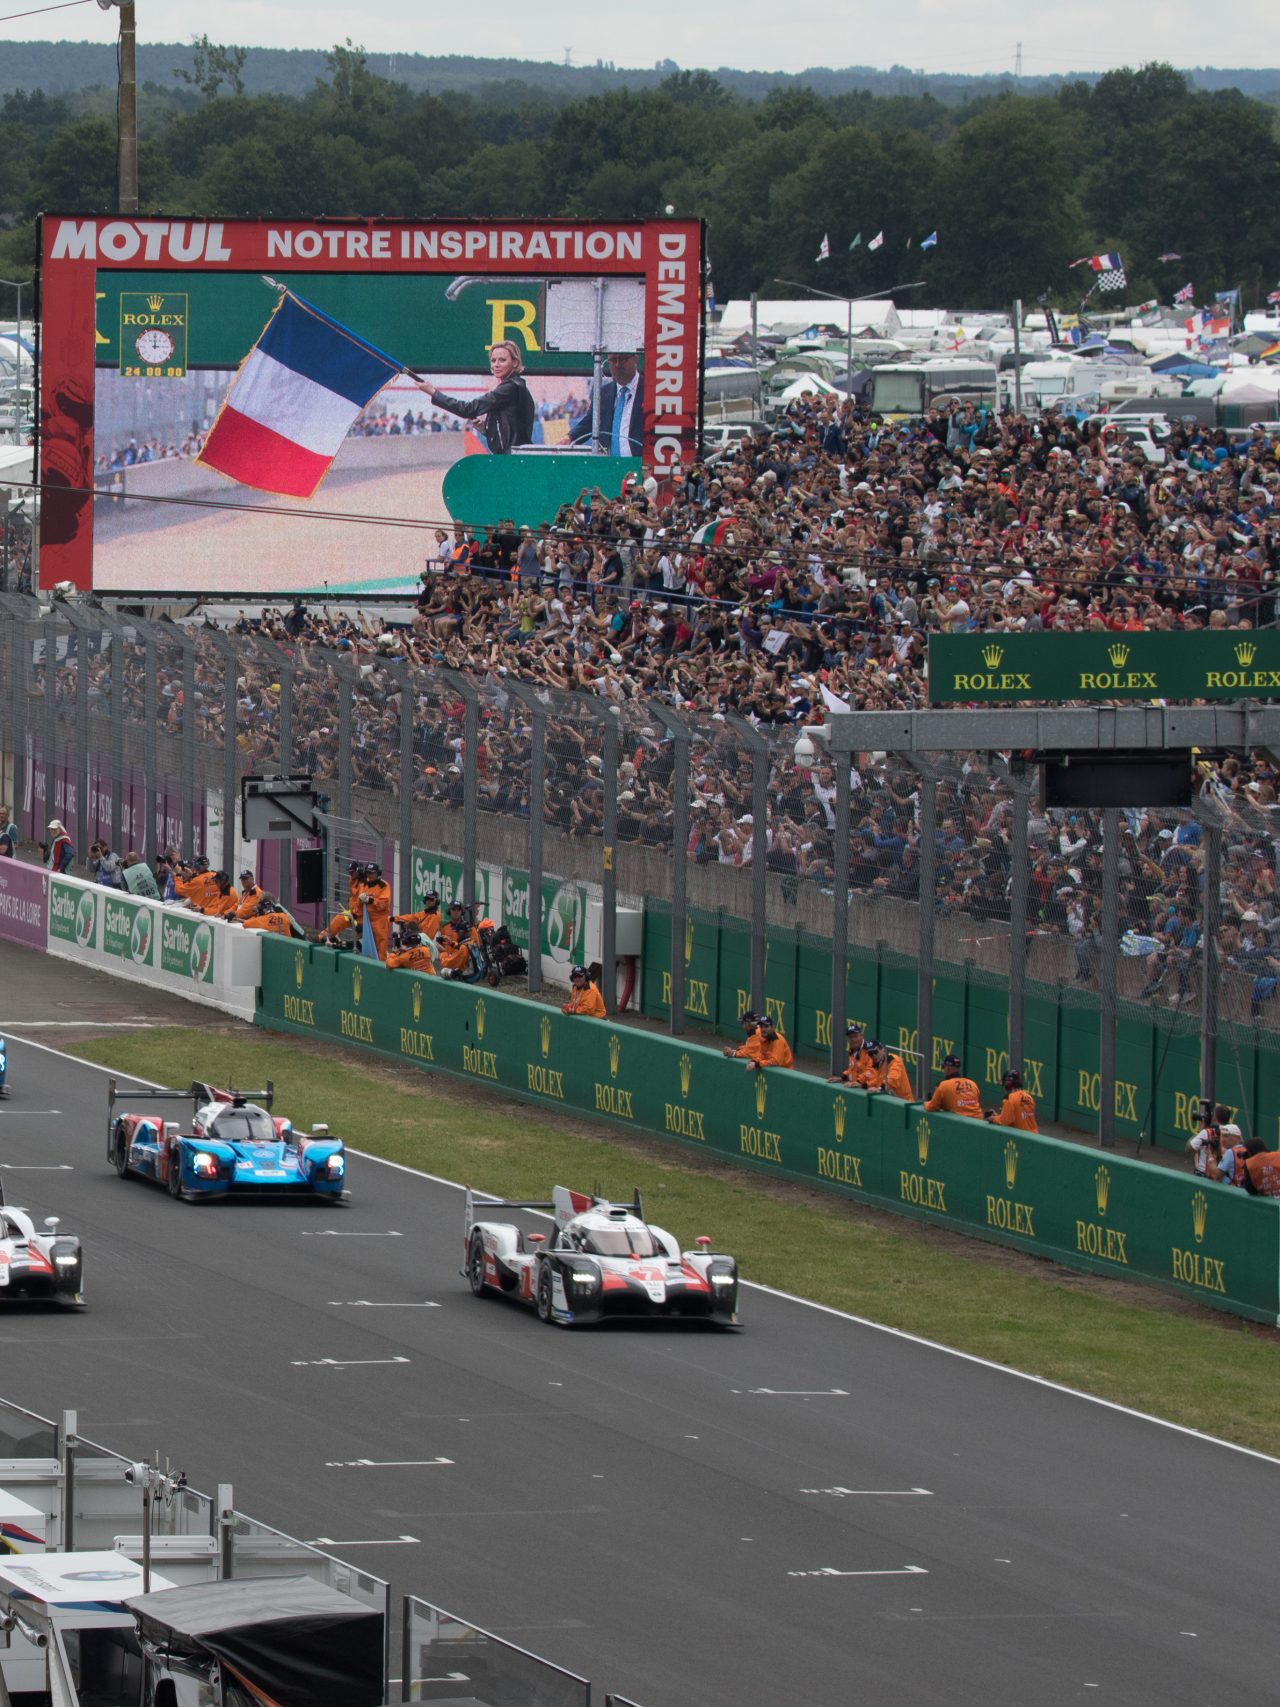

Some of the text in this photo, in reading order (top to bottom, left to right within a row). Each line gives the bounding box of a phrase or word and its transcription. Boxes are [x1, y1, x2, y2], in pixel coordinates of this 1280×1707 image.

[50, 221, 642, 262] MOTUL NOTRE INSPIRATION
[123, 313, 184, 325] ROLEX
[653, 233, 686, 475] DEMARRE ICI
[953, 674, 1032, 690] ROLEX
[1080, 672, 1158, 689] ROLEX
[1206, 671, 1280, 688] ROLEX
[415, 857, 453, 904] Sarthe
[505, 876, 546, 922] Sart
[0, 893, 40, 927] PAYS DE LA LOIRE
[52, 887, 75, 921] Sarthe
[106, 903, 130, 937] Sarthe
[163, 919, 189, 954] Sarthe
[283, 995, 315, 1026] ROLEX
[662, 971, 709, 1016] RLEX
[737, 989, 786, 1034] REX
[340, 1010, 373, 1044] ROLEX
[400, 1027, 434, 1061] ROLEX
[463, 1045, 498, 1080] ROLEX
[898, 1027, 954, 1073] ROEX
[527, 1063, 564, 1099] ROLEX
[986, 1047, 1044, 1099] ROEX
[595, 1083, 634, 1119] ROLEX
[1078, 1069, 1139, 1122] ROEX
[665, 1104, 705, 1141] ROLEX
[740, 1124, 782, 1163] ROLEX
[817, 1147, 863, 1187] ROLEX
[900, 1171, 947, 1212] ROLEX
[986, 1196, 1035, 1237] ROLEX
[1076, 1220, 1128, 1264] ROLEX
[644, 1269, 655, 1280] 7
[1172, 1247, 1225, 1293] ROLEX
